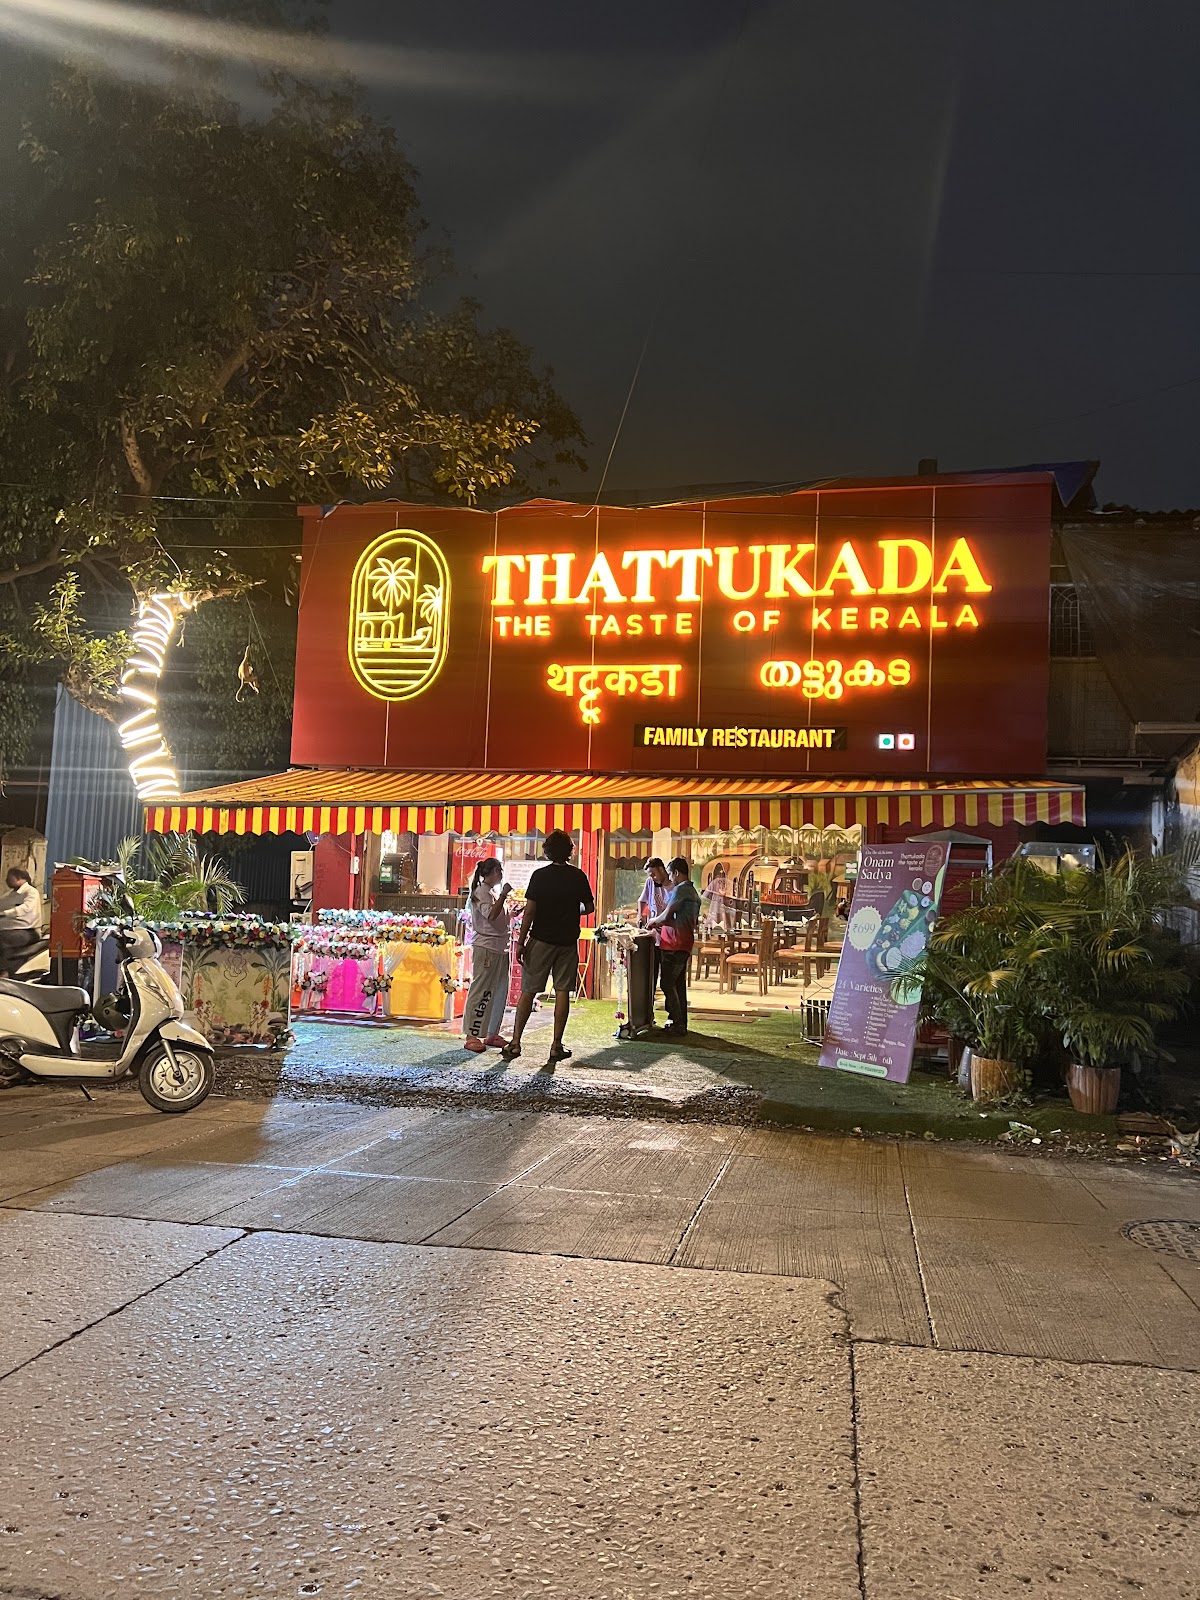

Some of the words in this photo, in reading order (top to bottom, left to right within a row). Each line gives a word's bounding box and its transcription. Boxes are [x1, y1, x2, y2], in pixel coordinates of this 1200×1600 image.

[481, 536, 992, 606] THATTUKADA
[494, 615, 551, 636] THE
[585, 612, 693, 636] TASTE
[733, 610, 781, 632] OF
[812, 604, 979, 631] KERALA
[643, 726, 708, 747] FAMILY
[712, 727, 835, 749] RESTAURANT
[864, 856, 895, 868] Onam
[860, 868, 892, 883] Sadya
[853, 923, 876, 934] ₹699
[837, 980, 847, 989] 24
[850, 981, 883, 994] Varieties
[469, 1021, 482, 1037] up
[835, 1047, 849, 1056] Date
[853, 1051, 866, 1061] Sept
[867, 1053, 878, 1062] 5th
[882, 1057, 893, 1065] 6th
